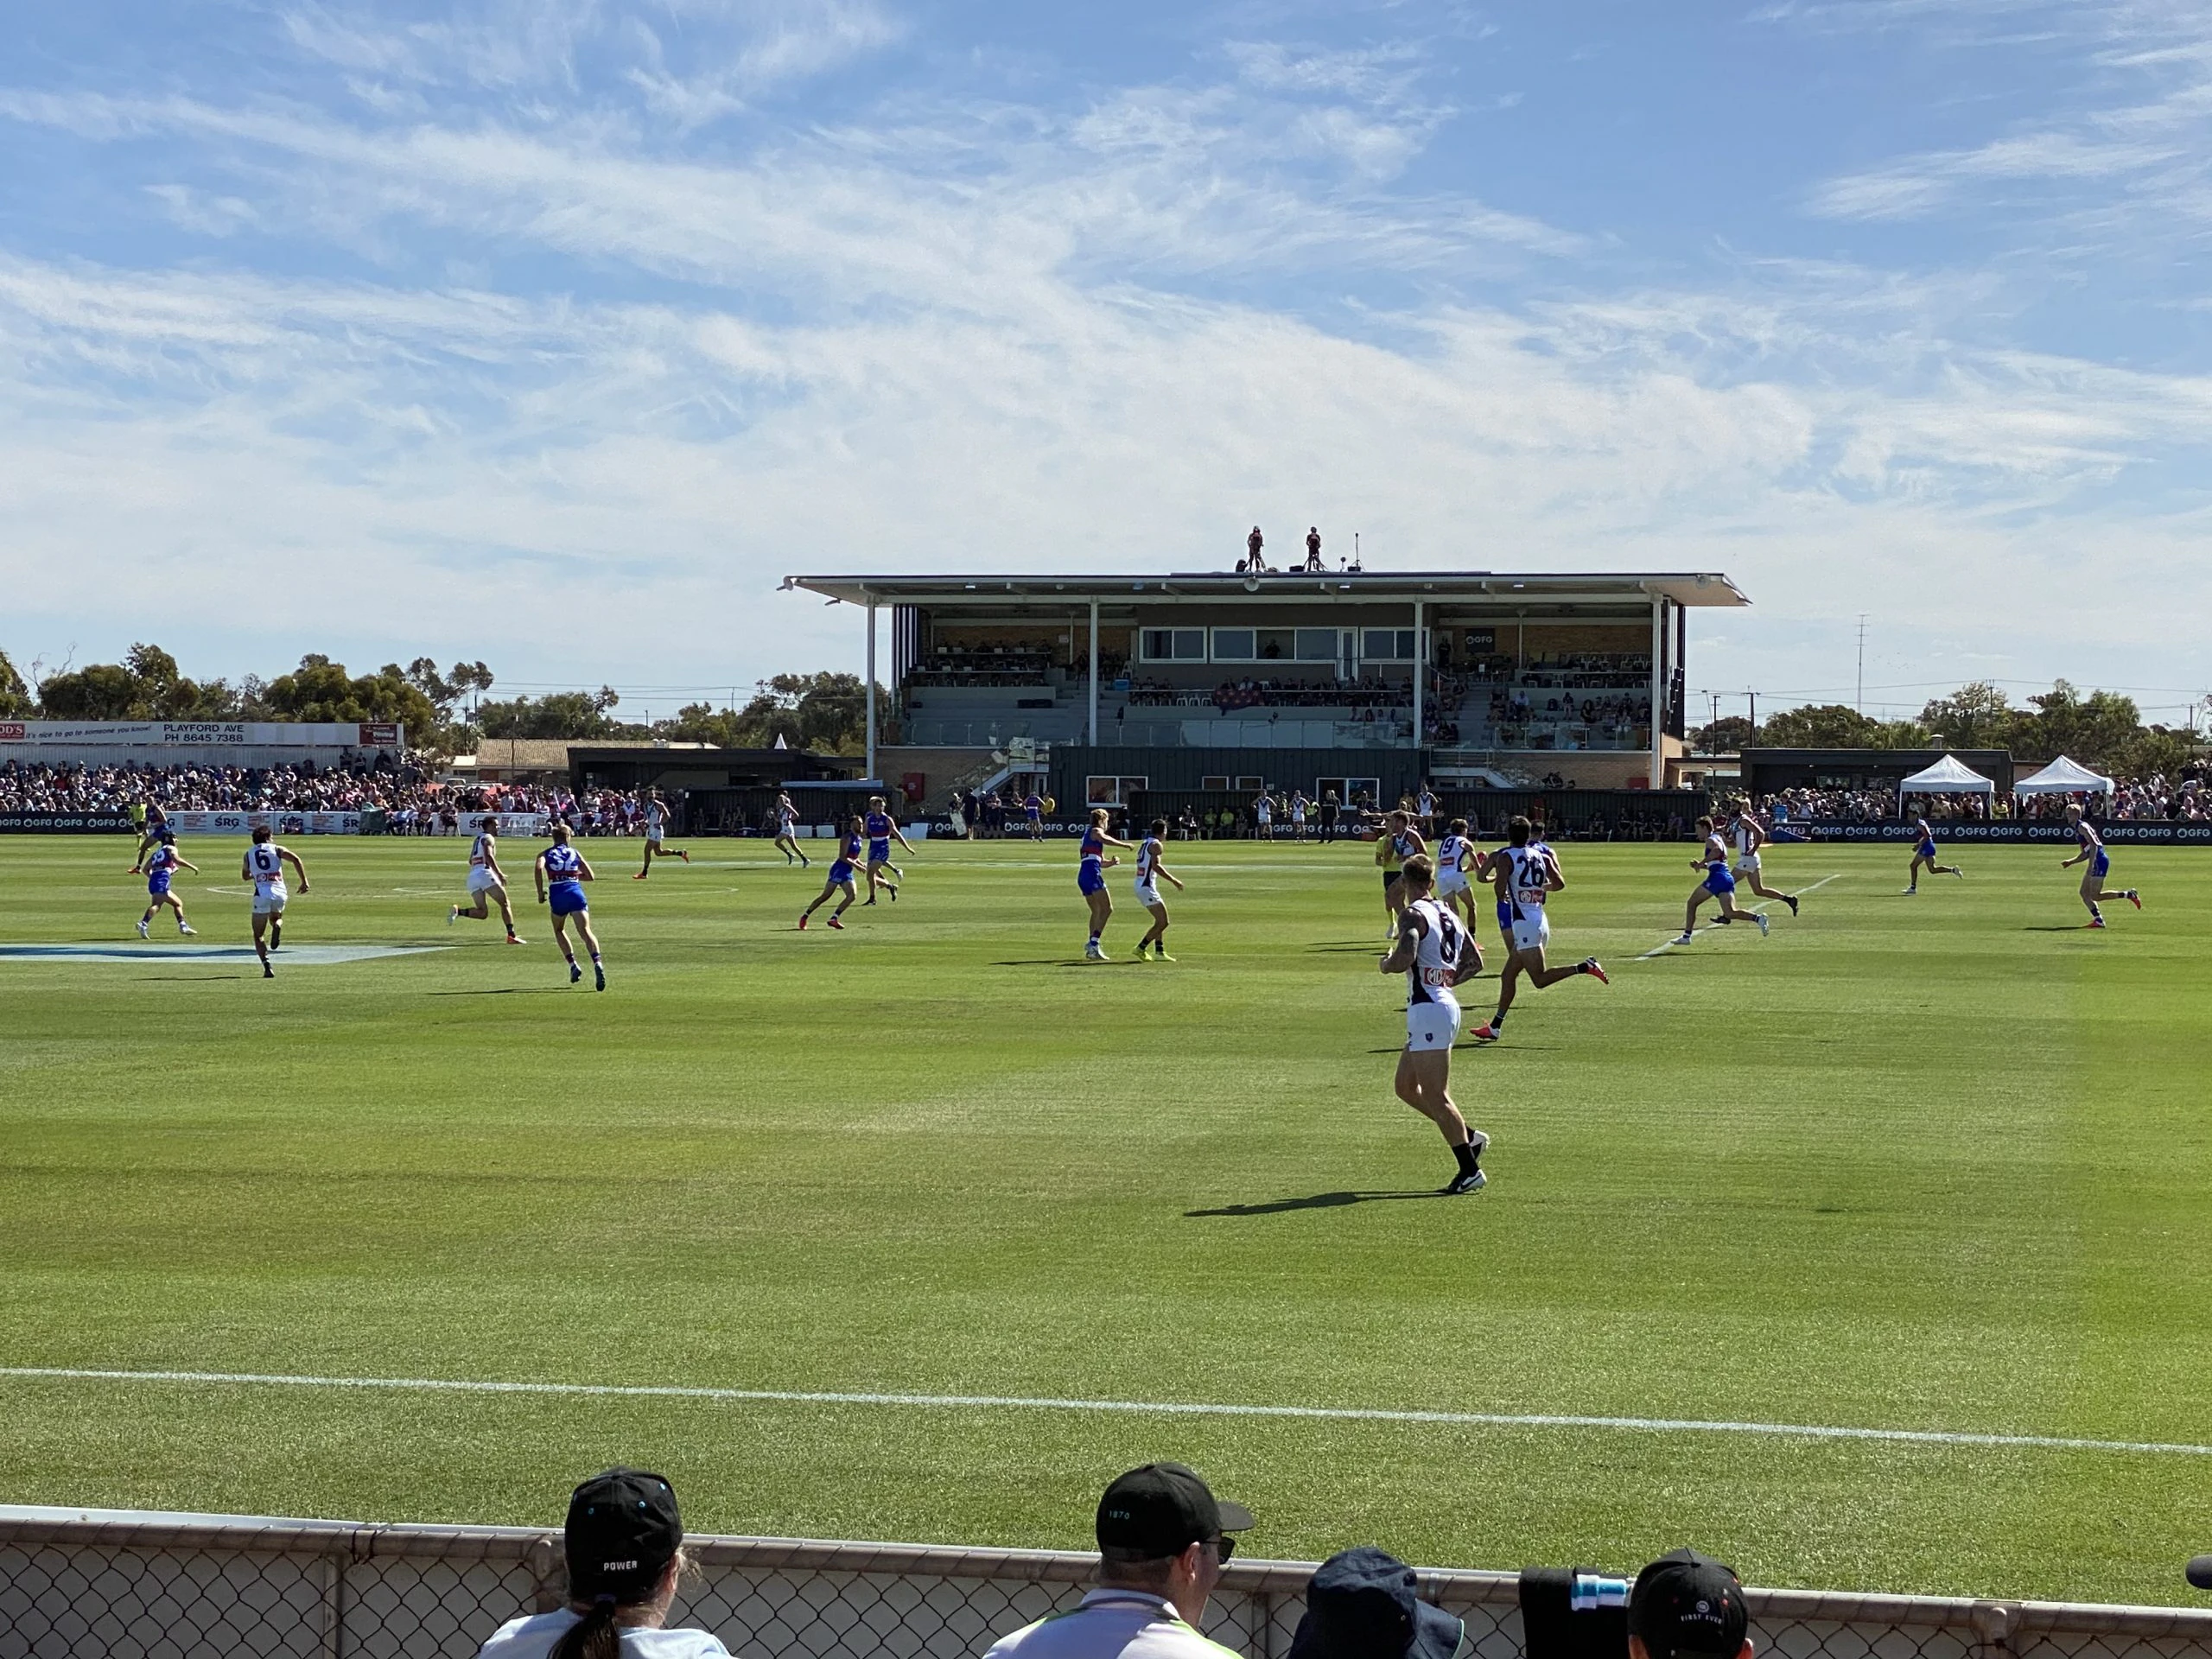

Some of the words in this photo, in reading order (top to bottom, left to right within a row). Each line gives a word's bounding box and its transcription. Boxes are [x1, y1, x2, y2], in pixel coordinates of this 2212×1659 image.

[183, 734, 212, 742] 8645
[216, 734, 244, 742] 7388
[214, 816, 240, 829] SRG
[1438, 838, 1456, 857] 19
[255, 849, 270, 870] 6
[550, 847, 579, 871] 32
[1518, 855, 1545, 887] 26
[1440, 912, 1456, 963] 8
[1109, 1510, 1130, 1520] 1870
[604, 1560, 638, 1571] POWER
[1681, 1613, 1701, 1622] FIRST
[1706, 1614, 1722, 1624] EVER
